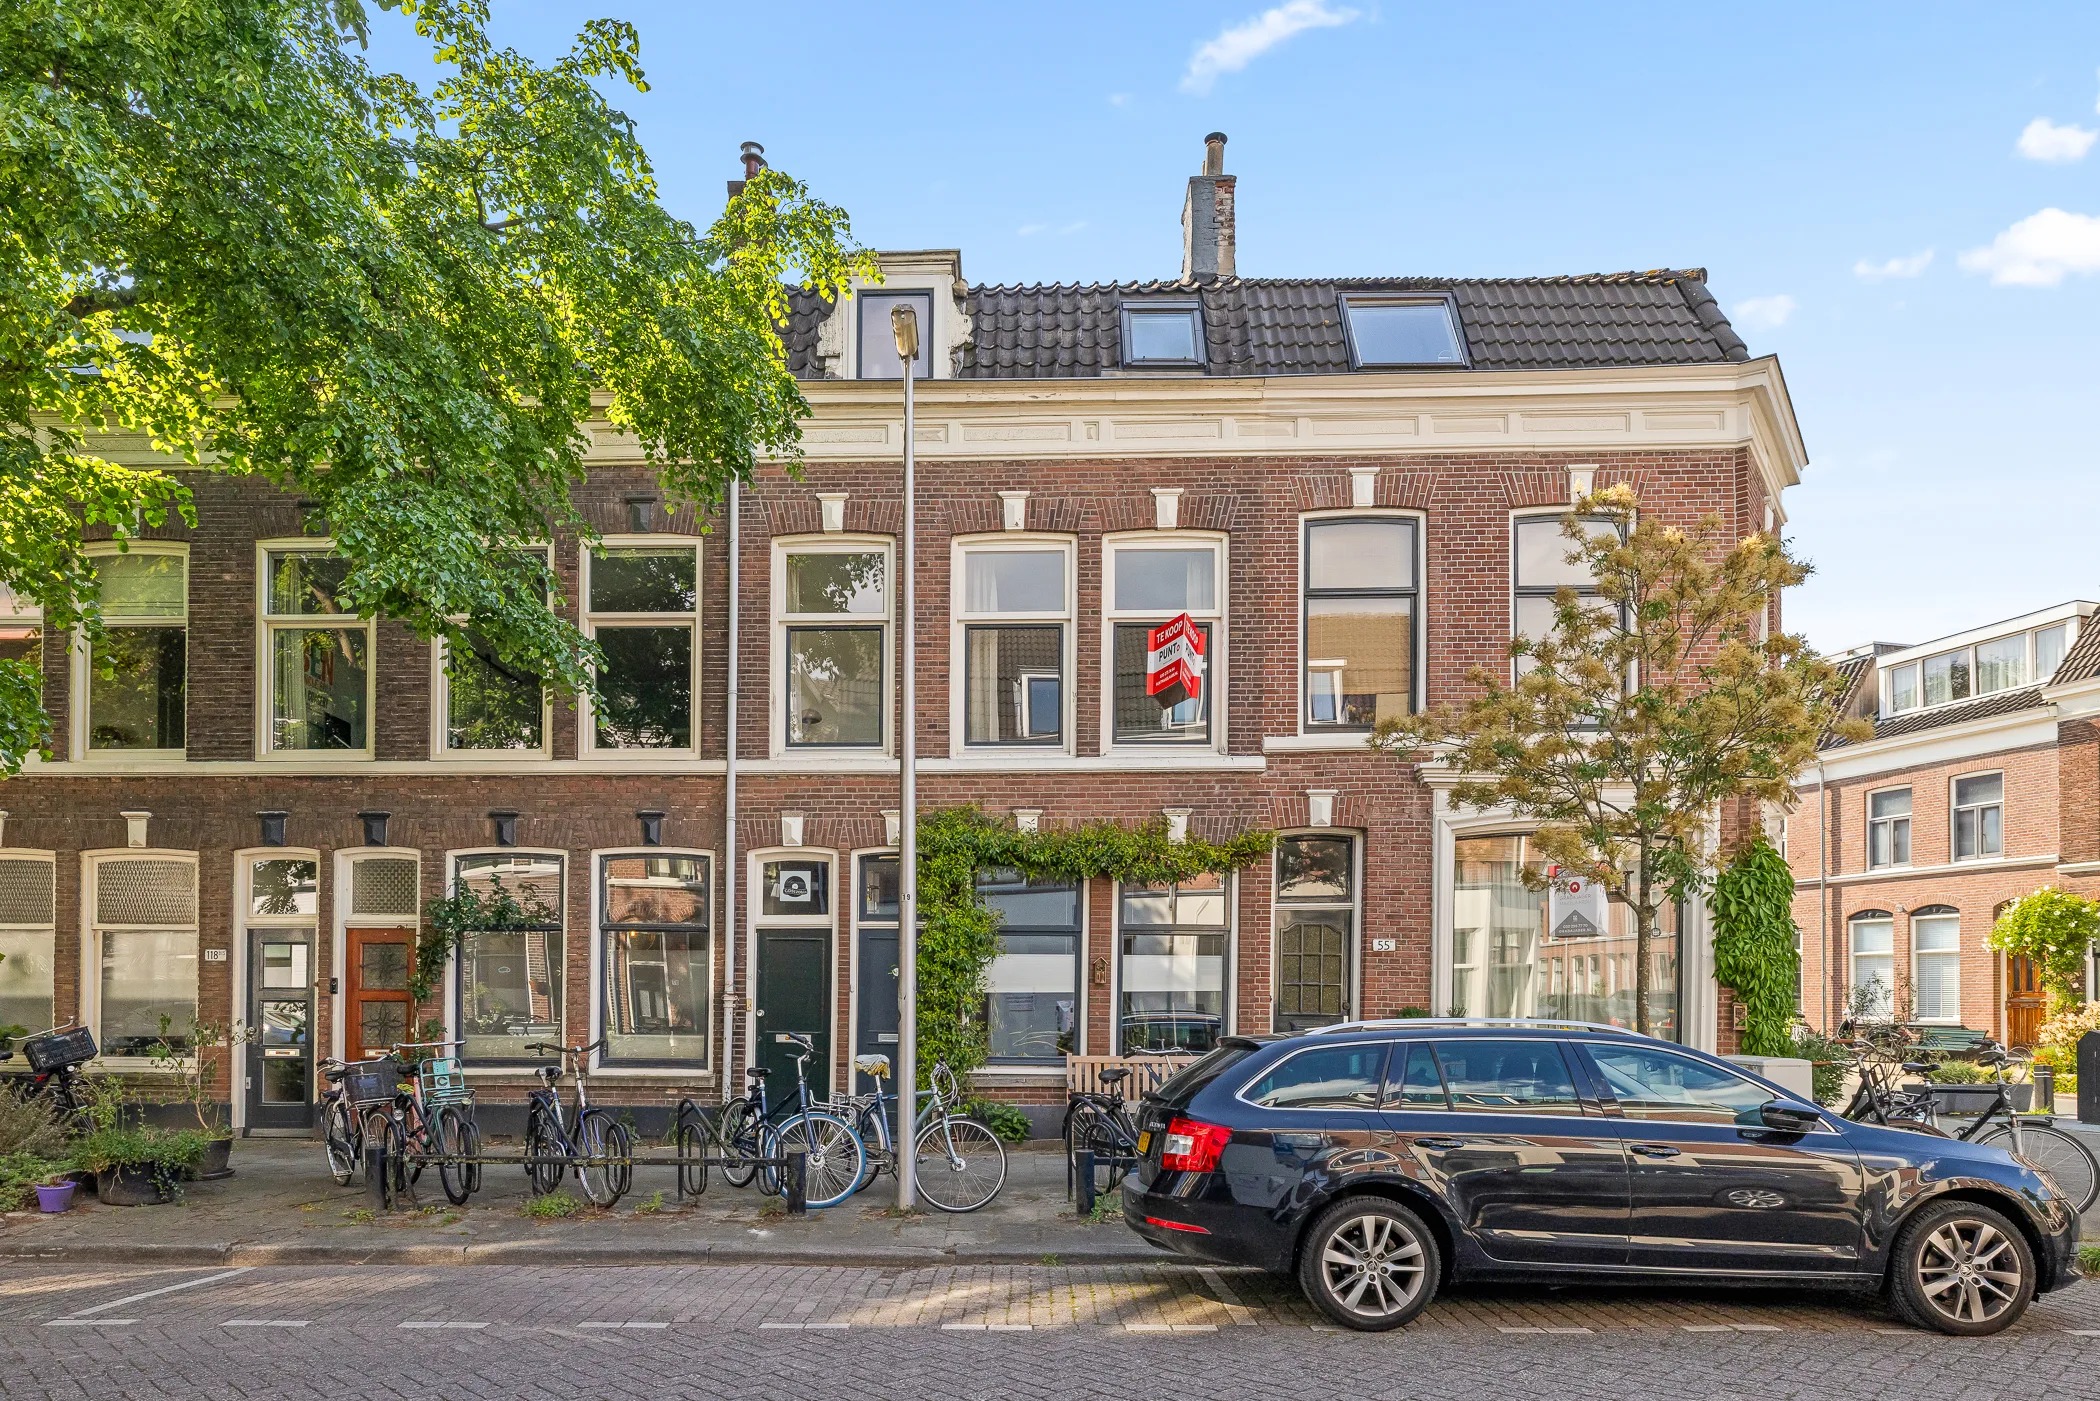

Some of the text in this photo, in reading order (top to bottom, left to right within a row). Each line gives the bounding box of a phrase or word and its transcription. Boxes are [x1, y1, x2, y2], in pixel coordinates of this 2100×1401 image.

[1157, 621, 1183, 643] TE KOOP
[901, 893, 911, 901] 19
[1377, 940, 1390, 951] 55
[206, 950, 219, 960] 118
